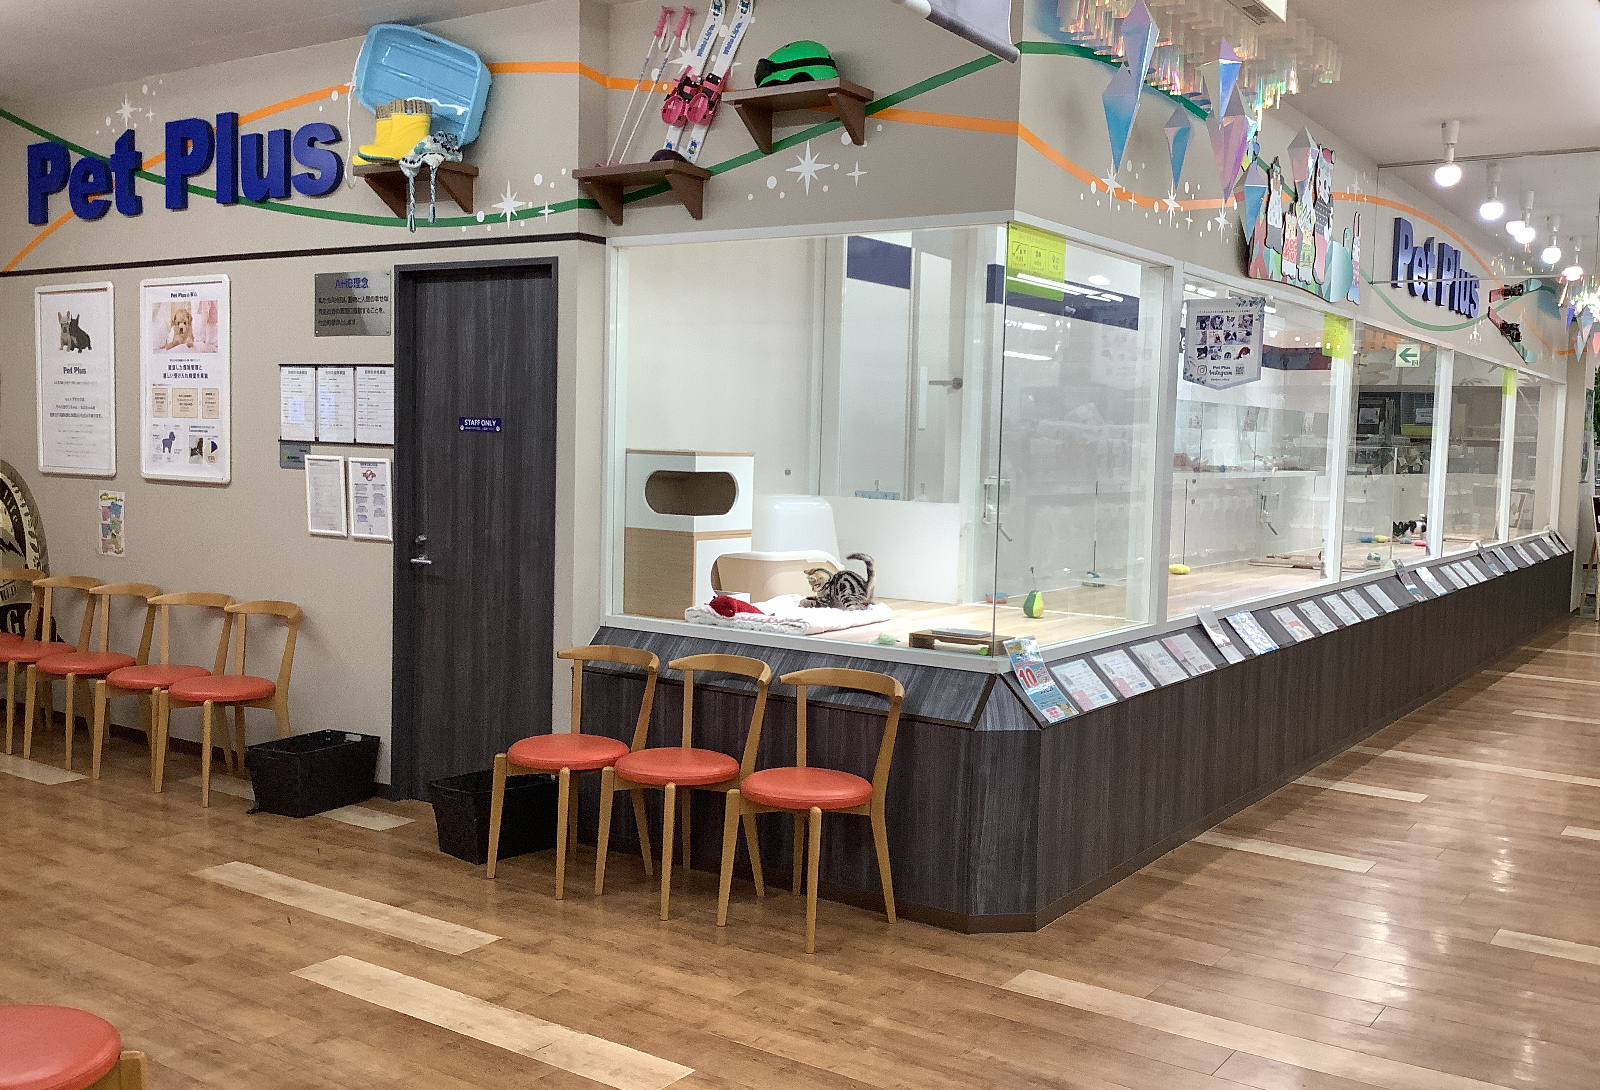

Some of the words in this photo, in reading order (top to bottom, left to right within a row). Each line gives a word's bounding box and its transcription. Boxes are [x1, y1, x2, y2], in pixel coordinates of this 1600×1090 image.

[27, 128, 143, 225] Pet
[165, 112, 344, 210] Plus
[1391, 217, 1436, 302] Pet
[1436, 242, 1480, 319] Plus
[63, 366, 73, 375] Pet
[73, 366, 87, 375] Plus
[481, 419, 497, 427] ONLY
[1018, 667, 1038, 689] 10
